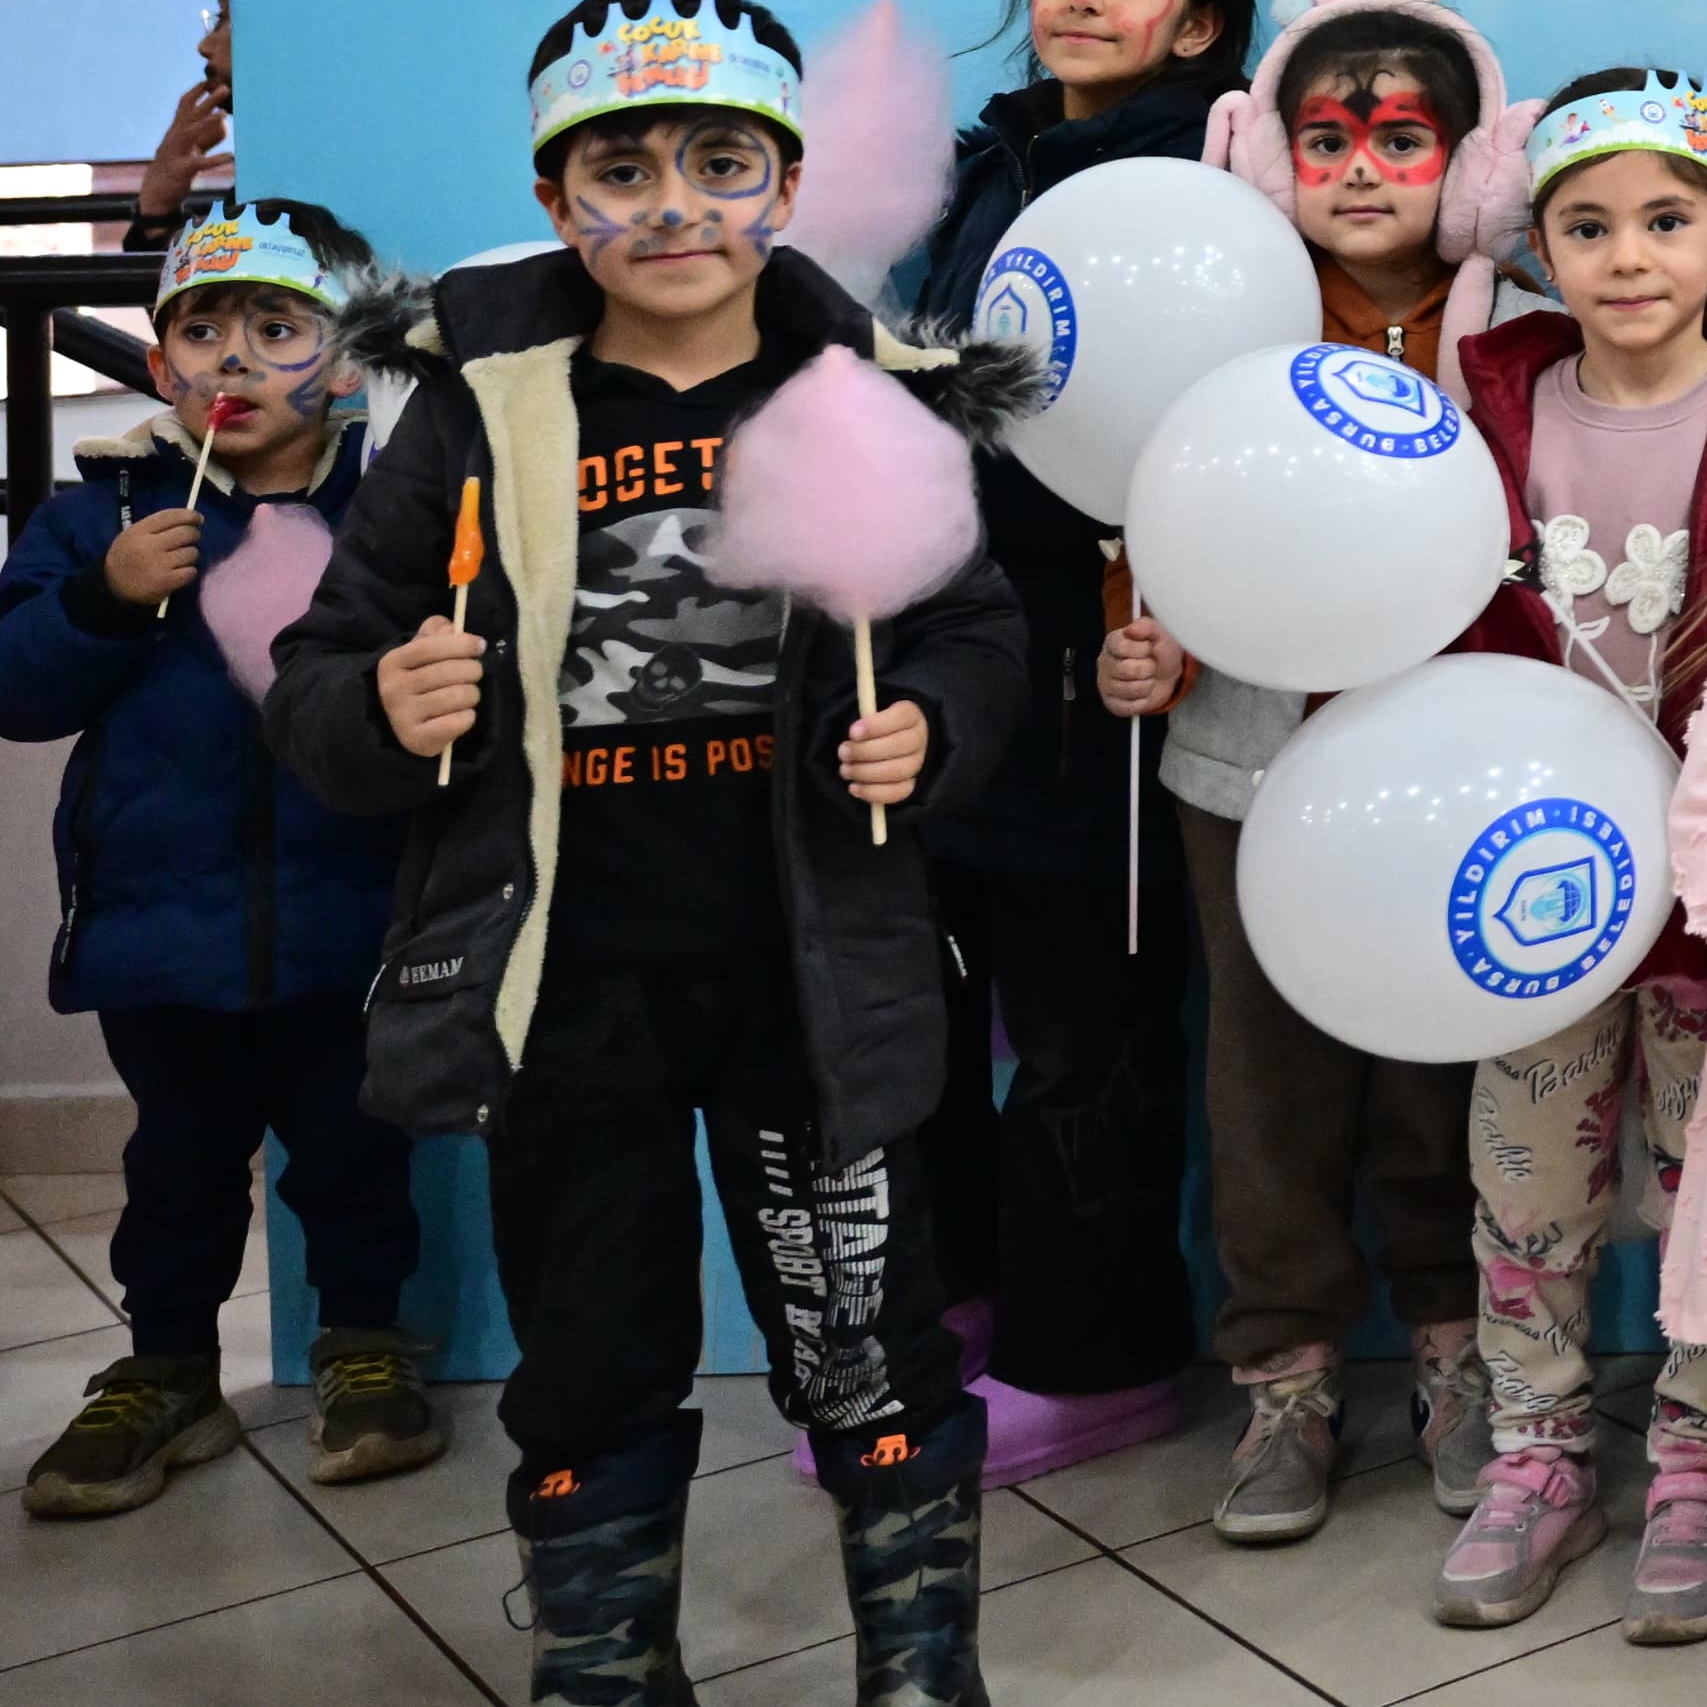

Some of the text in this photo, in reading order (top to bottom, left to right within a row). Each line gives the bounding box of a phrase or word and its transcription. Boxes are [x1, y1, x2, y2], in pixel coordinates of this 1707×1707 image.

[1005, 253, 1072, 336] YILDIRIM
[1311, 397, 1397, 452] BURSA
[652, 743, 688, 782] IS
[1454, 807, 1547, 945] YILDIRIM
[1471, 957, 1561, 995] BURSA
